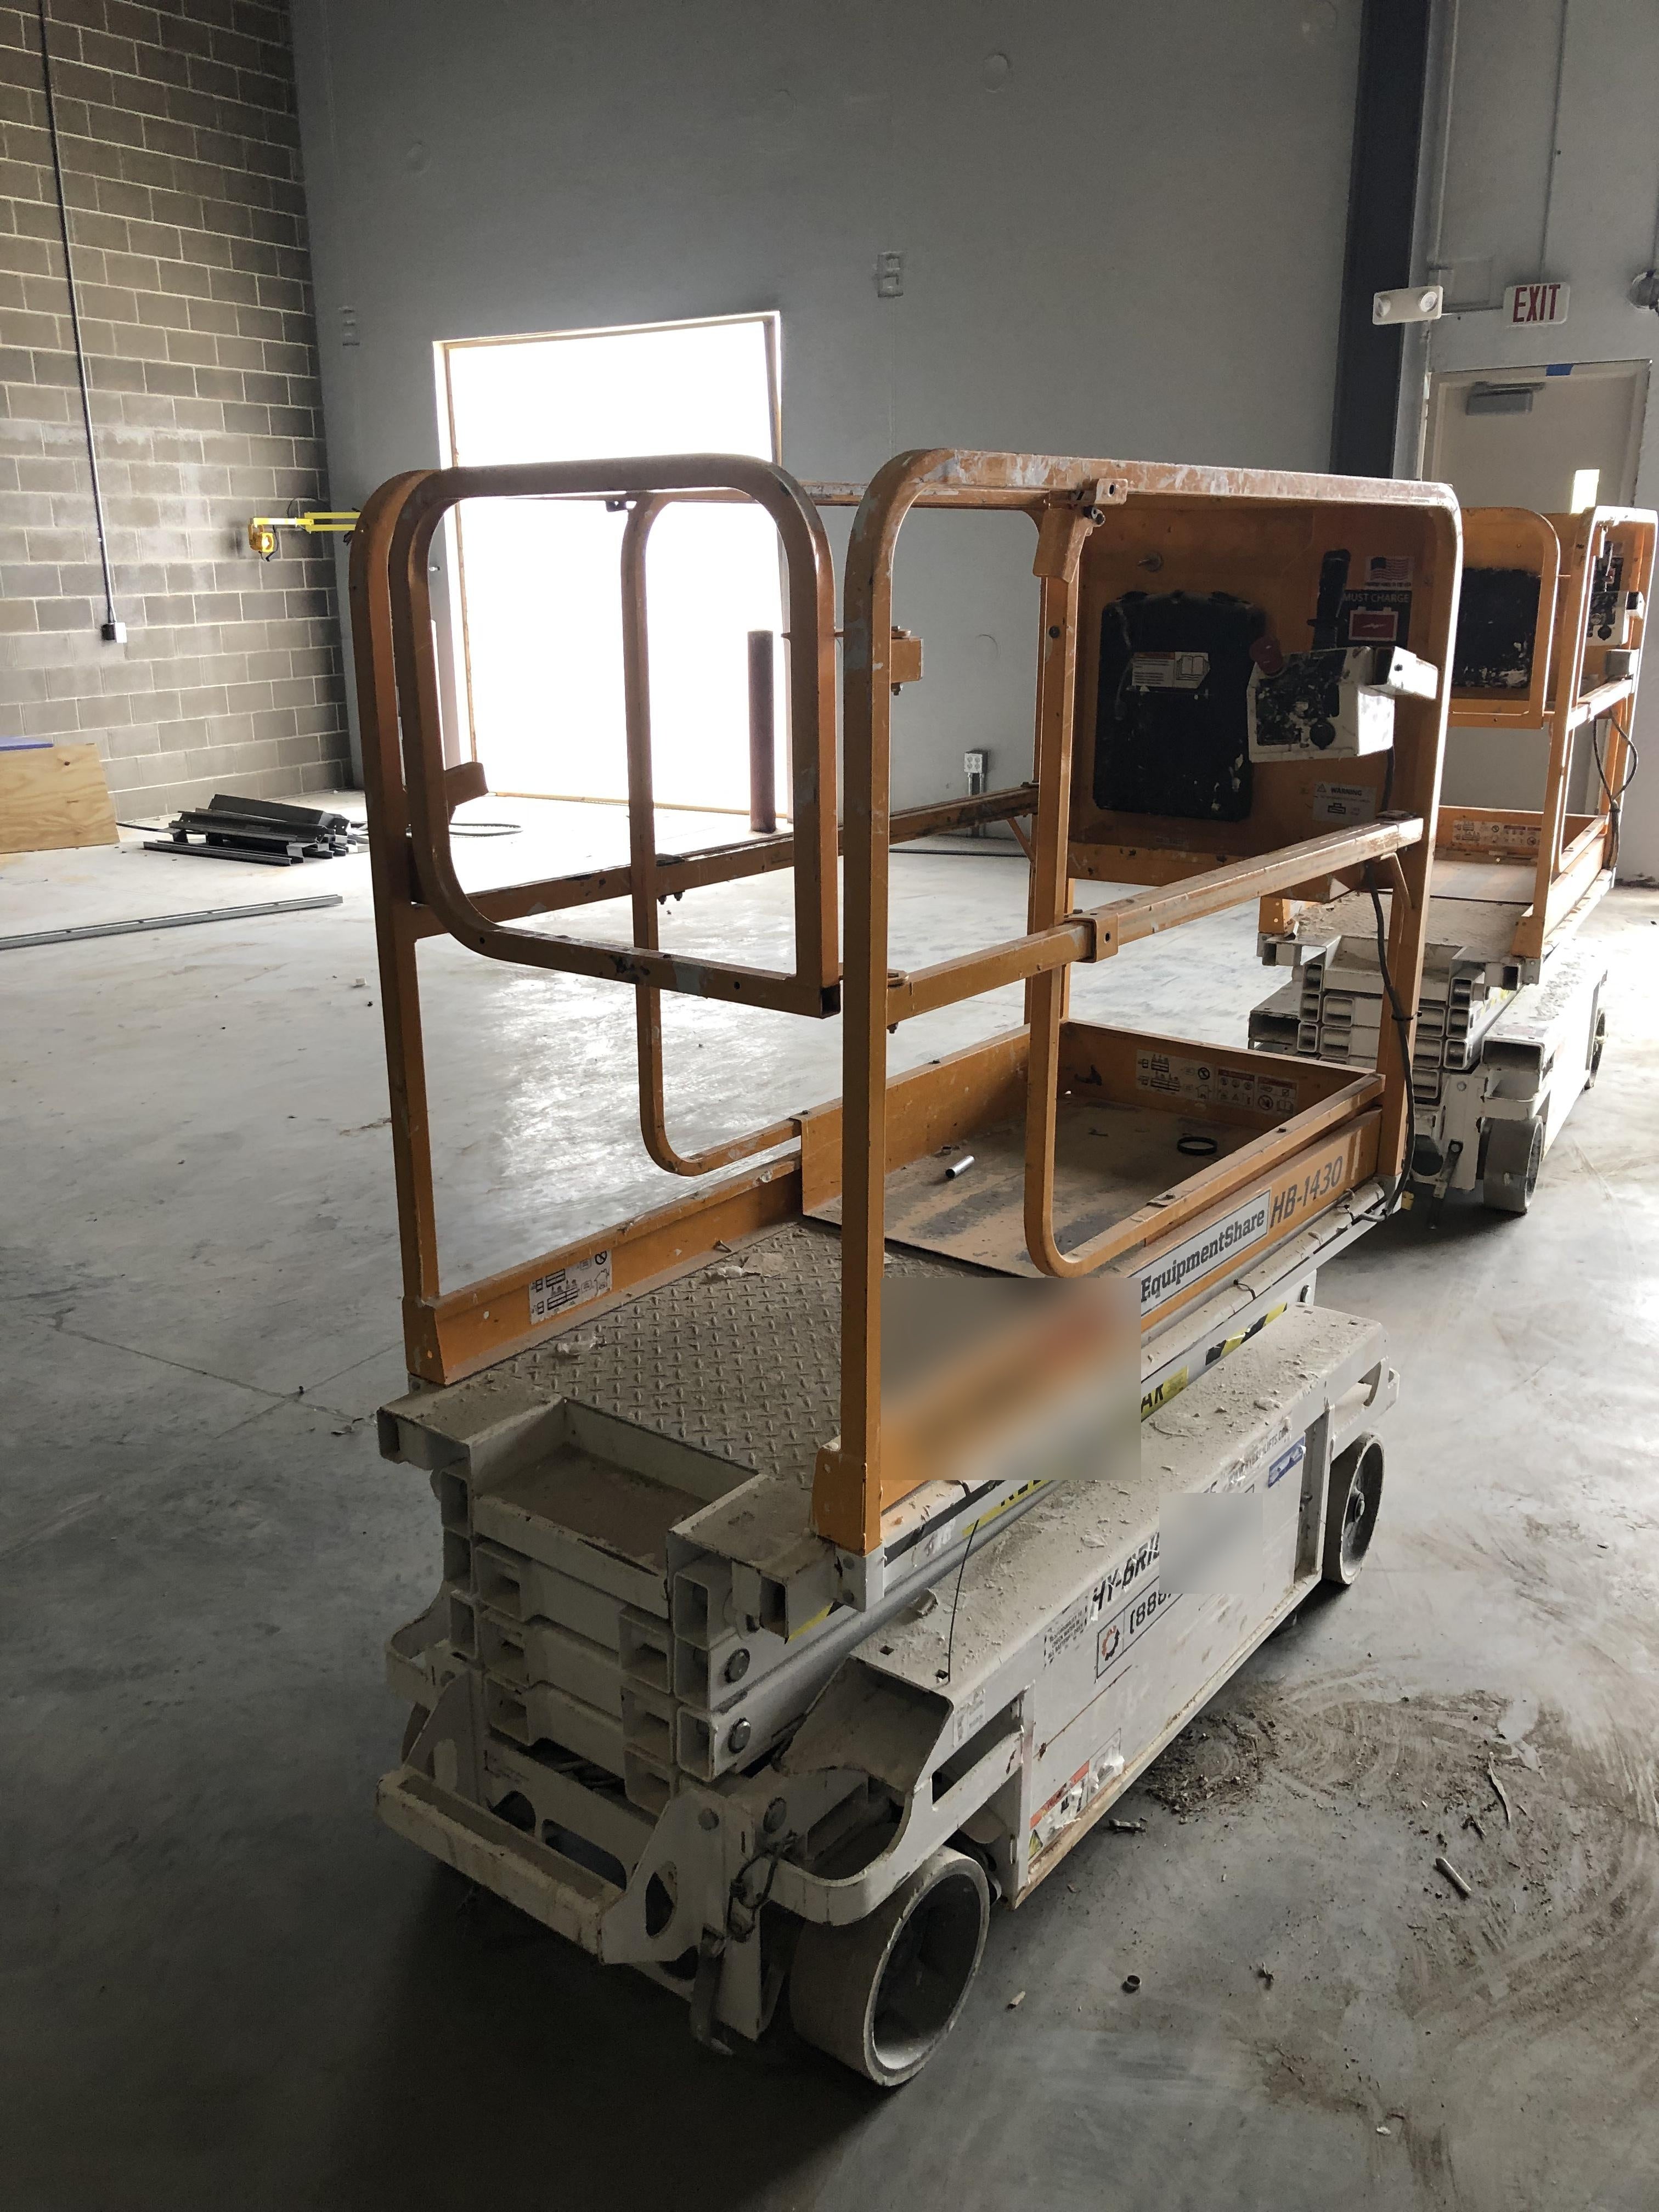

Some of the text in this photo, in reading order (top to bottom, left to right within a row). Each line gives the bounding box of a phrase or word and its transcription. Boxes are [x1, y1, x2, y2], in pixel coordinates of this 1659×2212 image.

[1513, 284, 1561, 323] EXIT
[1344, 593, 1410, 603] MUST CHARGE
[1331, 787, 1362, 796] WARNING
[1270, 1155, 1343, 1228] HB-1430
[1141, 1209, 1265, 1304] EquipmentShare
